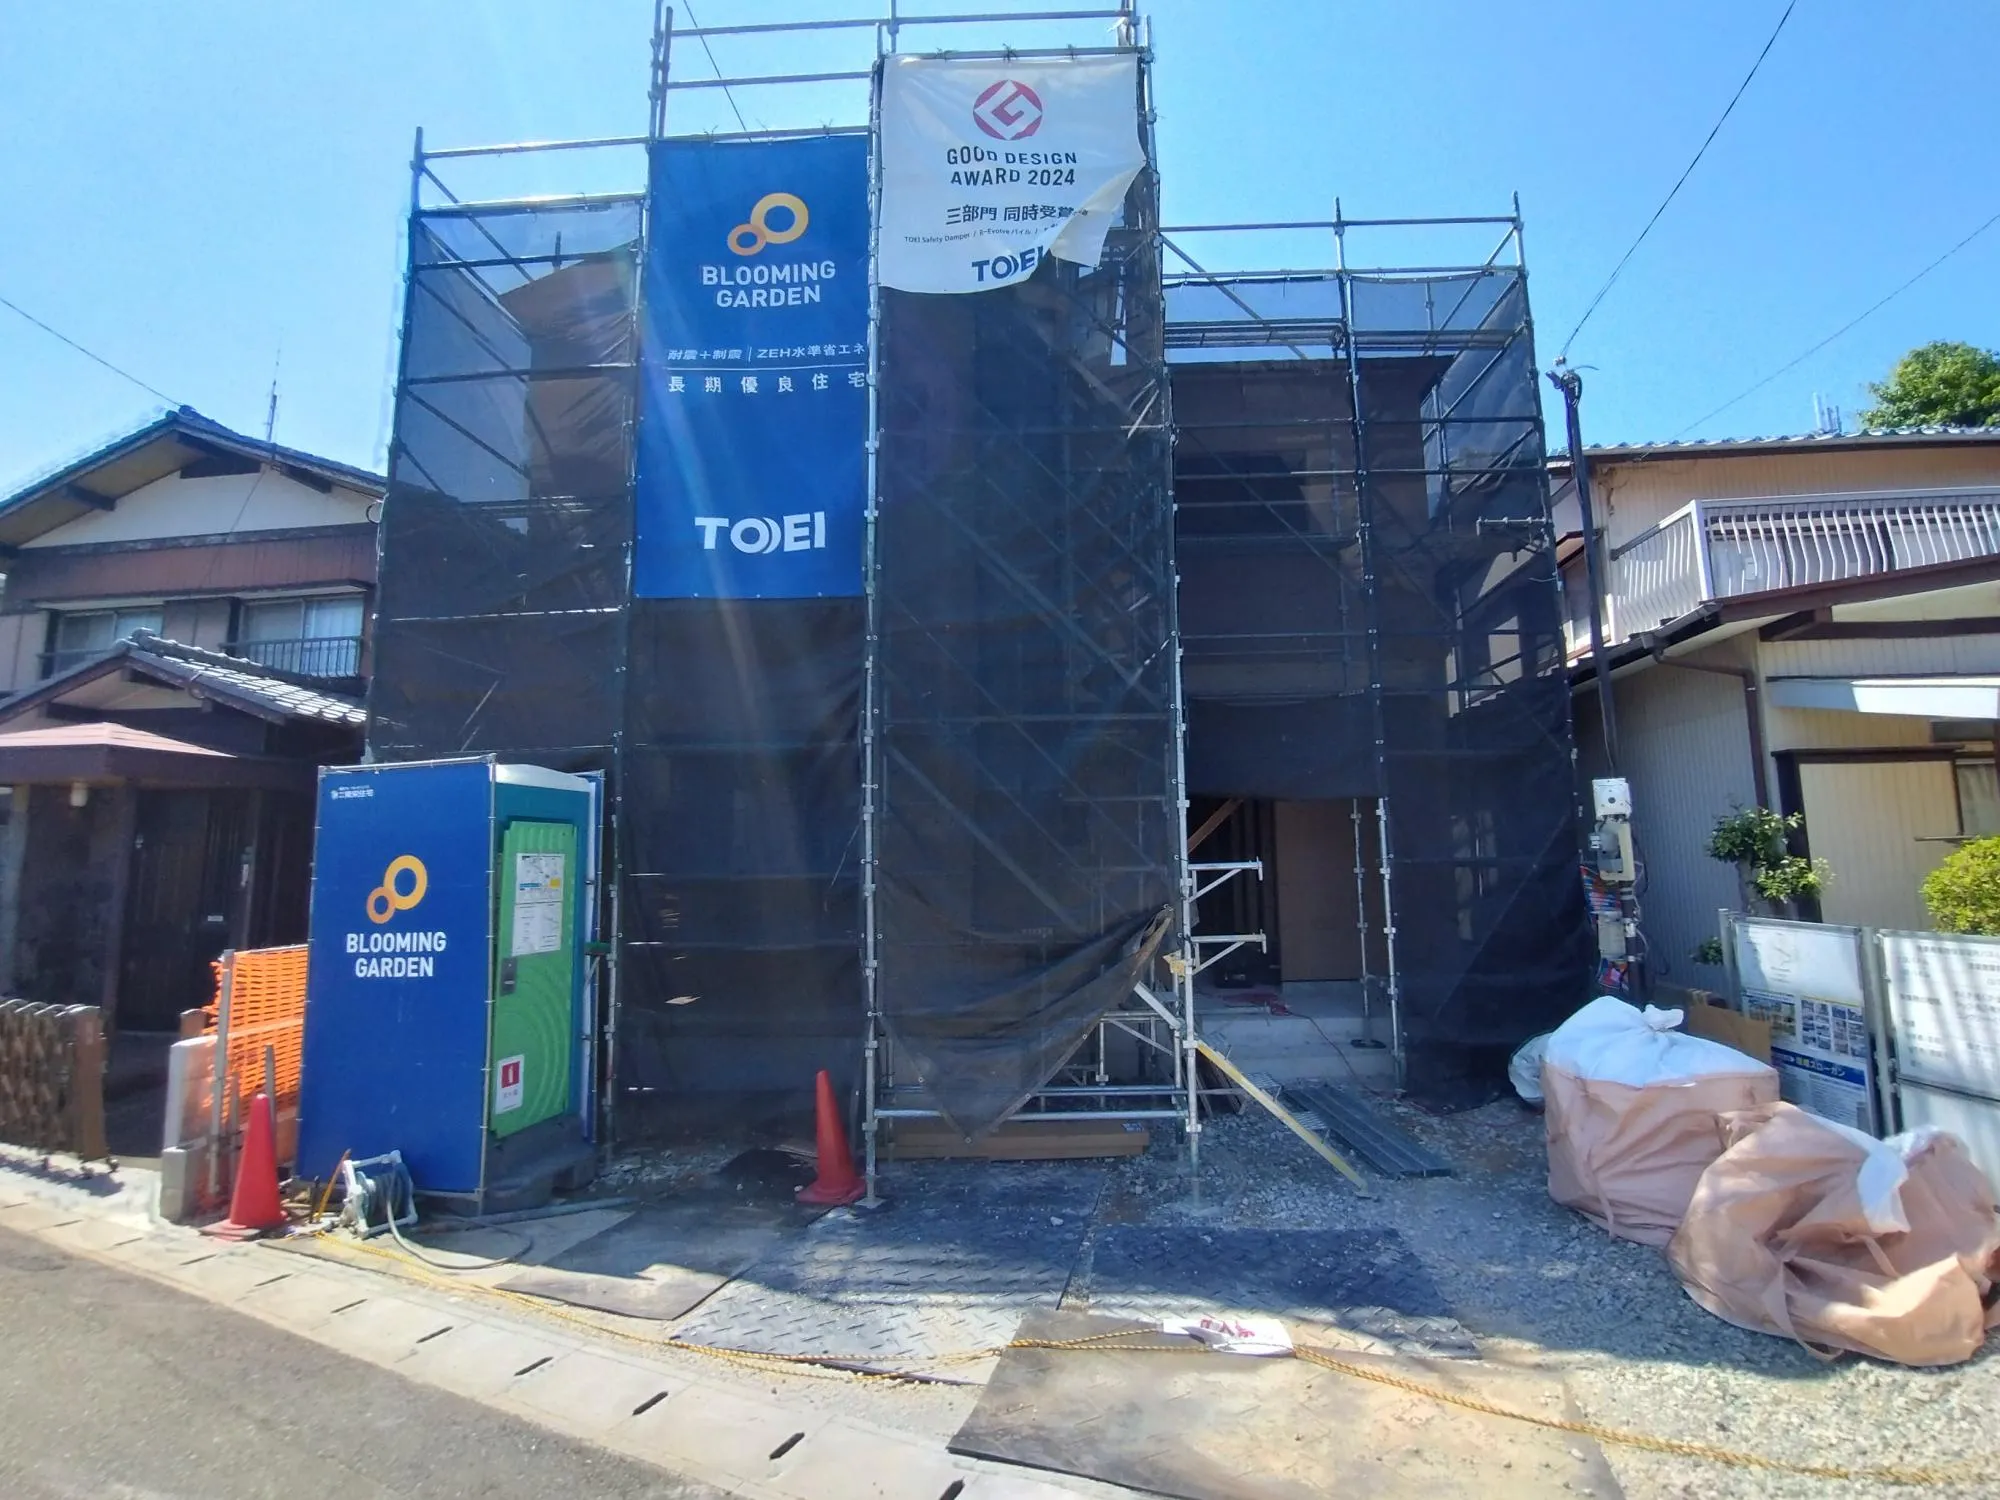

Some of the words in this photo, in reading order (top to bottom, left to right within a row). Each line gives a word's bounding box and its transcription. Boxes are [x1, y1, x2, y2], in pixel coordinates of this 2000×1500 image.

[946, 145, 998, 165] GOOD
[1004, 151, 1077, 165] DESIGN
[950, 167, 1020, 186] AWARD
[1027, 168, 1075, 186] 2024
[946, 205, 997, 225] 三部門
[922, 235, 943, 244] Safety
[944, 232, 970, 242] Damper
[702, 260, 836, 286] BLOOMING
[716, 284, 821, 308] GARDEN
[668, 371, 865, 394] 長期優良住宅
[694, 511, 826, 554] TOEI
[346, 931, 447, 953] BLOOMING
[355, 956, 434, 978] GARDEN
